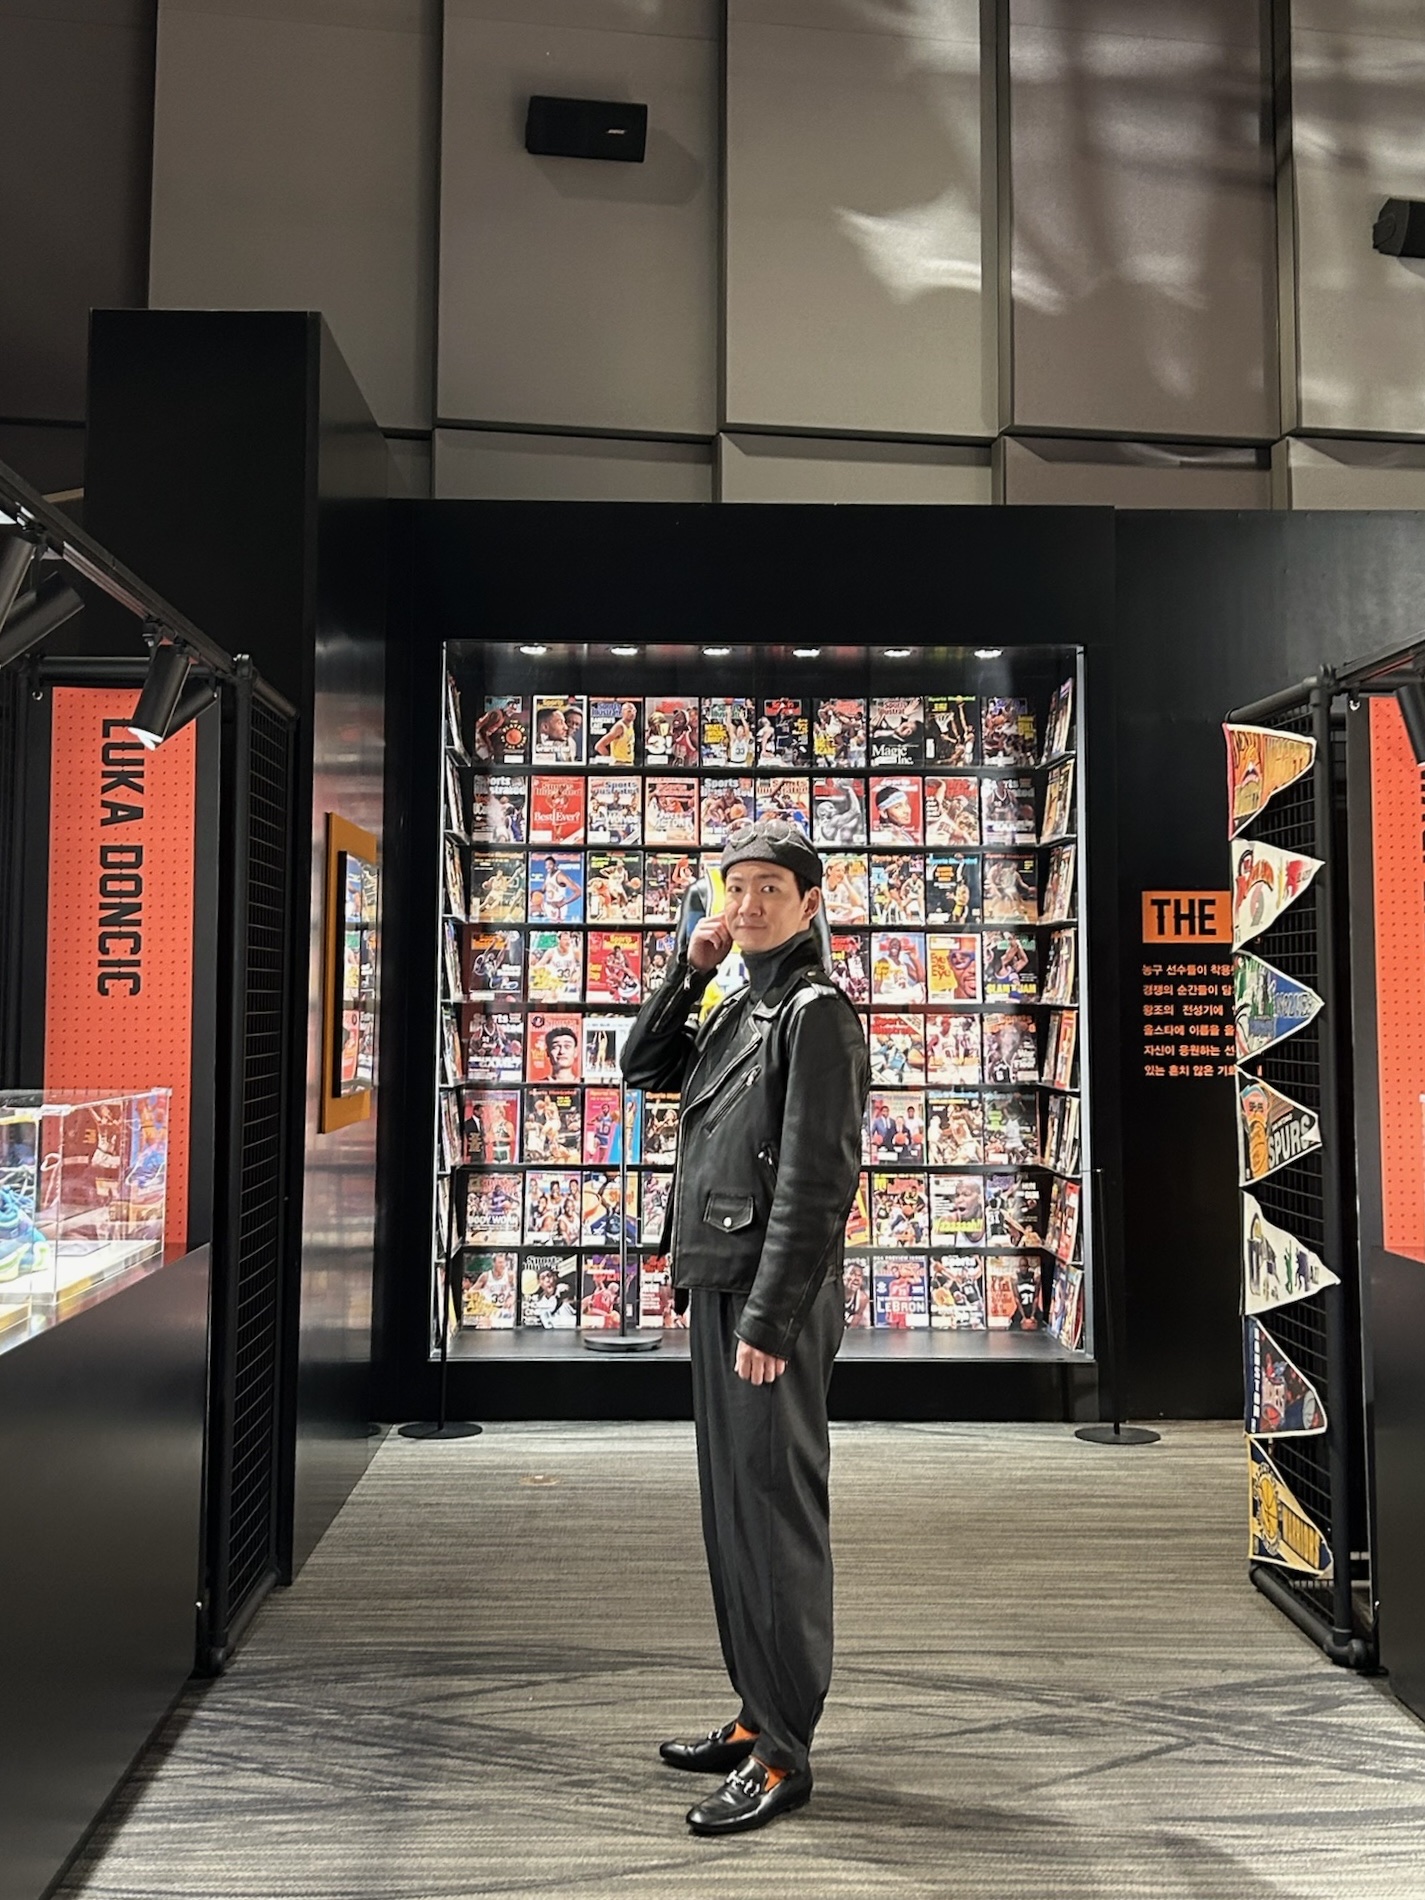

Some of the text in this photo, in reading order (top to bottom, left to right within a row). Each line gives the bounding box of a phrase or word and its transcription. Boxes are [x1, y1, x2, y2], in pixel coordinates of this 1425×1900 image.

[872, 743, 907, 758] Magic
[897, 755, 914, 765] Inc.
[704, 778, 739, 790] Sports
[534, 811, 553, 822] Best
[555, 811, 580, 822] Ever?
[97, 718, 144, 997] LUKA DONCIC
[1151, 899, 1217, 936] THE
[557, 968, 571, 978] 33
[1142, 963, 1235, 976] 농구 선수들이 착용
[1143, 984, 1235, 997] 경쟁의 순간들이 담
[1143, 1004, 1175, 1017] 왕조의
[1182, 1004, 1224, 1016] 전성기에
[1143, 1024, 1236, 1036] 올스타에 이름을 올
[1144, 1045, 1236, 1057] 자신이 응원하는 선
[1144, 1065, 1165, 1076] 있는
[1169, 1064, 1190, 1076] 흔치
[1193, 1064, 1214, 1076] 않은
[1268, 1114, 1311, 1169] SPURS
[491, 1293, 505, 1304] 33
[1020, 1292, 1034, 1305] 21
